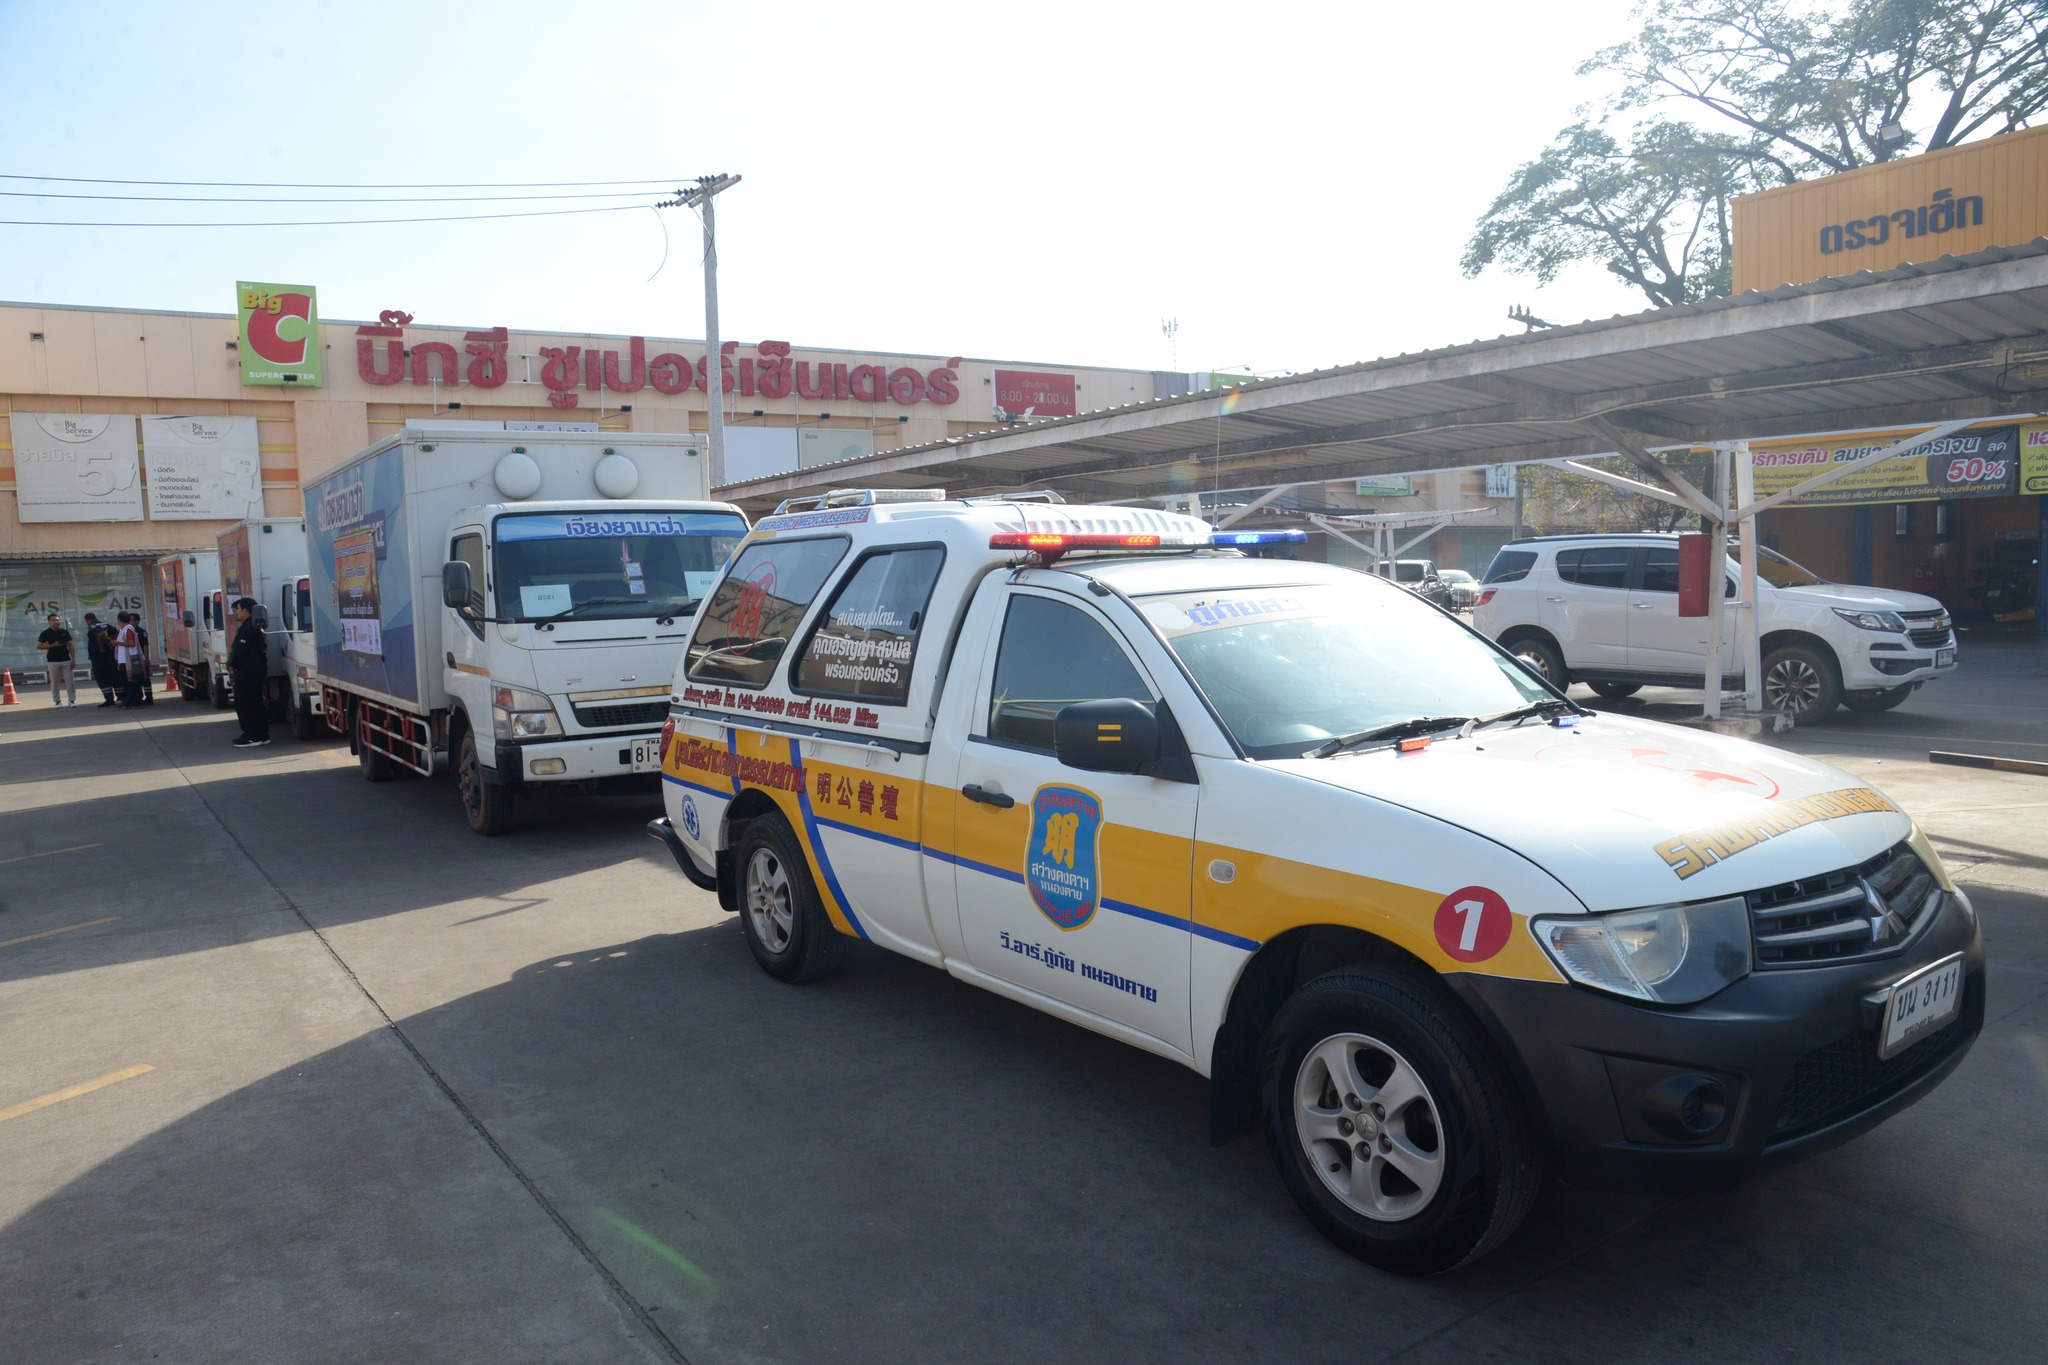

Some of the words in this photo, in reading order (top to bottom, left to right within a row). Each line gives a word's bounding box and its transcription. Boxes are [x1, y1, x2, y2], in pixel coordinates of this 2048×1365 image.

[1820, 187, 1983, 255] ตรวจเช็ก
[243, 291, 283, 315] Big
[247, 293, 312, 365] C
[355, 309, 509, 389] บิ๊กซี
[249, 371, 316, 380] SUPERCTER
[1000, 390, 1022, 402] 8.00
[65, 420, 77, 429] Big
[192, 423, 203, 431] Big
[1946, 457, 2006, 482] 50%
[565, 514, 687, 537] เจียงยามาฮ่า
[755, 517, 797, 531] EMERGENCY
[797, 513, 830, 527] MEDICAL
[831, 510, 868, 523] SERVICE
[25, 601, 60, 615] AIS
[109, 596, 142, 610] AIS
[1031, 880, 1075, 924] RESCUE
[1040, 880, 1083, 901] หนองคาย
[1454, 899, 1485, 952] 1
[1081, 963, 1157, 1003] หนองคาย
[1923, 967, 1957, 1008] 3111
